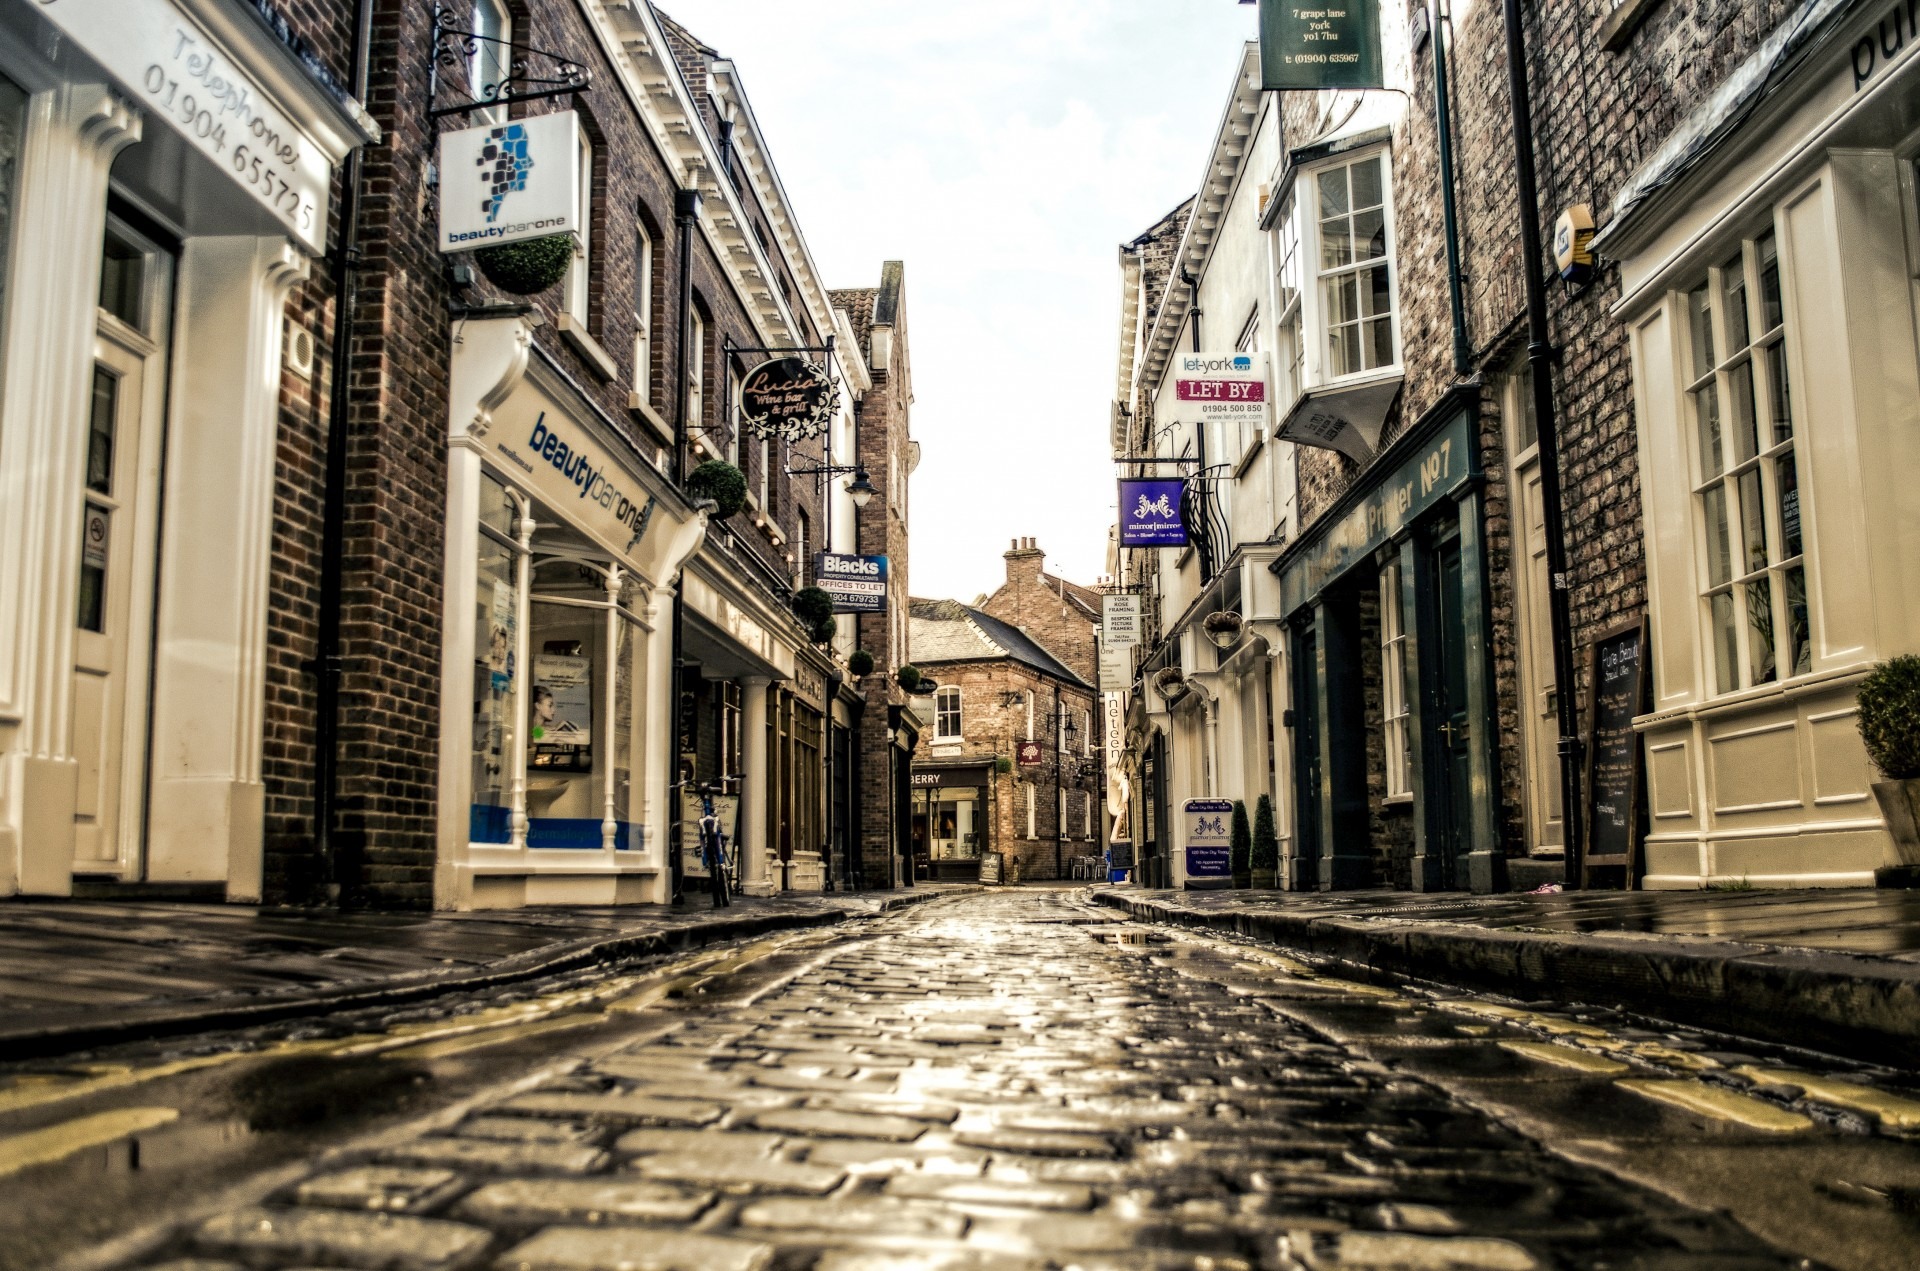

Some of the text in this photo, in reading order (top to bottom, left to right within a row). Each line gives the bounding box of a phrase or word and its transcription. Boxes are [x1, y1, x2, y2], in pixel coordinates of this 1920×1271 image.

[1293, 9, 1345, 19] 7 grape lane
[1310, 21, 1330, 30] york
[1304, 32, 1338, 42] yo1 7hu
[1295, 55, 1326, 64] (01904)
[1330, 54, 1358, 63] 635967
[144, 63, 313, 230] 01904 655725
[449, 217, 565, 242] beautybarone
[745, 372, 819, 394] Lucia
[1189, 382, 1251, 398] LET BY
[754, 392, 804, 405] Wine bar
[772, 401, 808, 416] & grill
[529, 411, 646, 533] beautybarone
[824, 556, 879, 574] Blacks
[829, 593, 878, 603] 1904 679733
[1109, 691, 1119, 758] ineteen
[910, 774, 940, 784] BERRY
